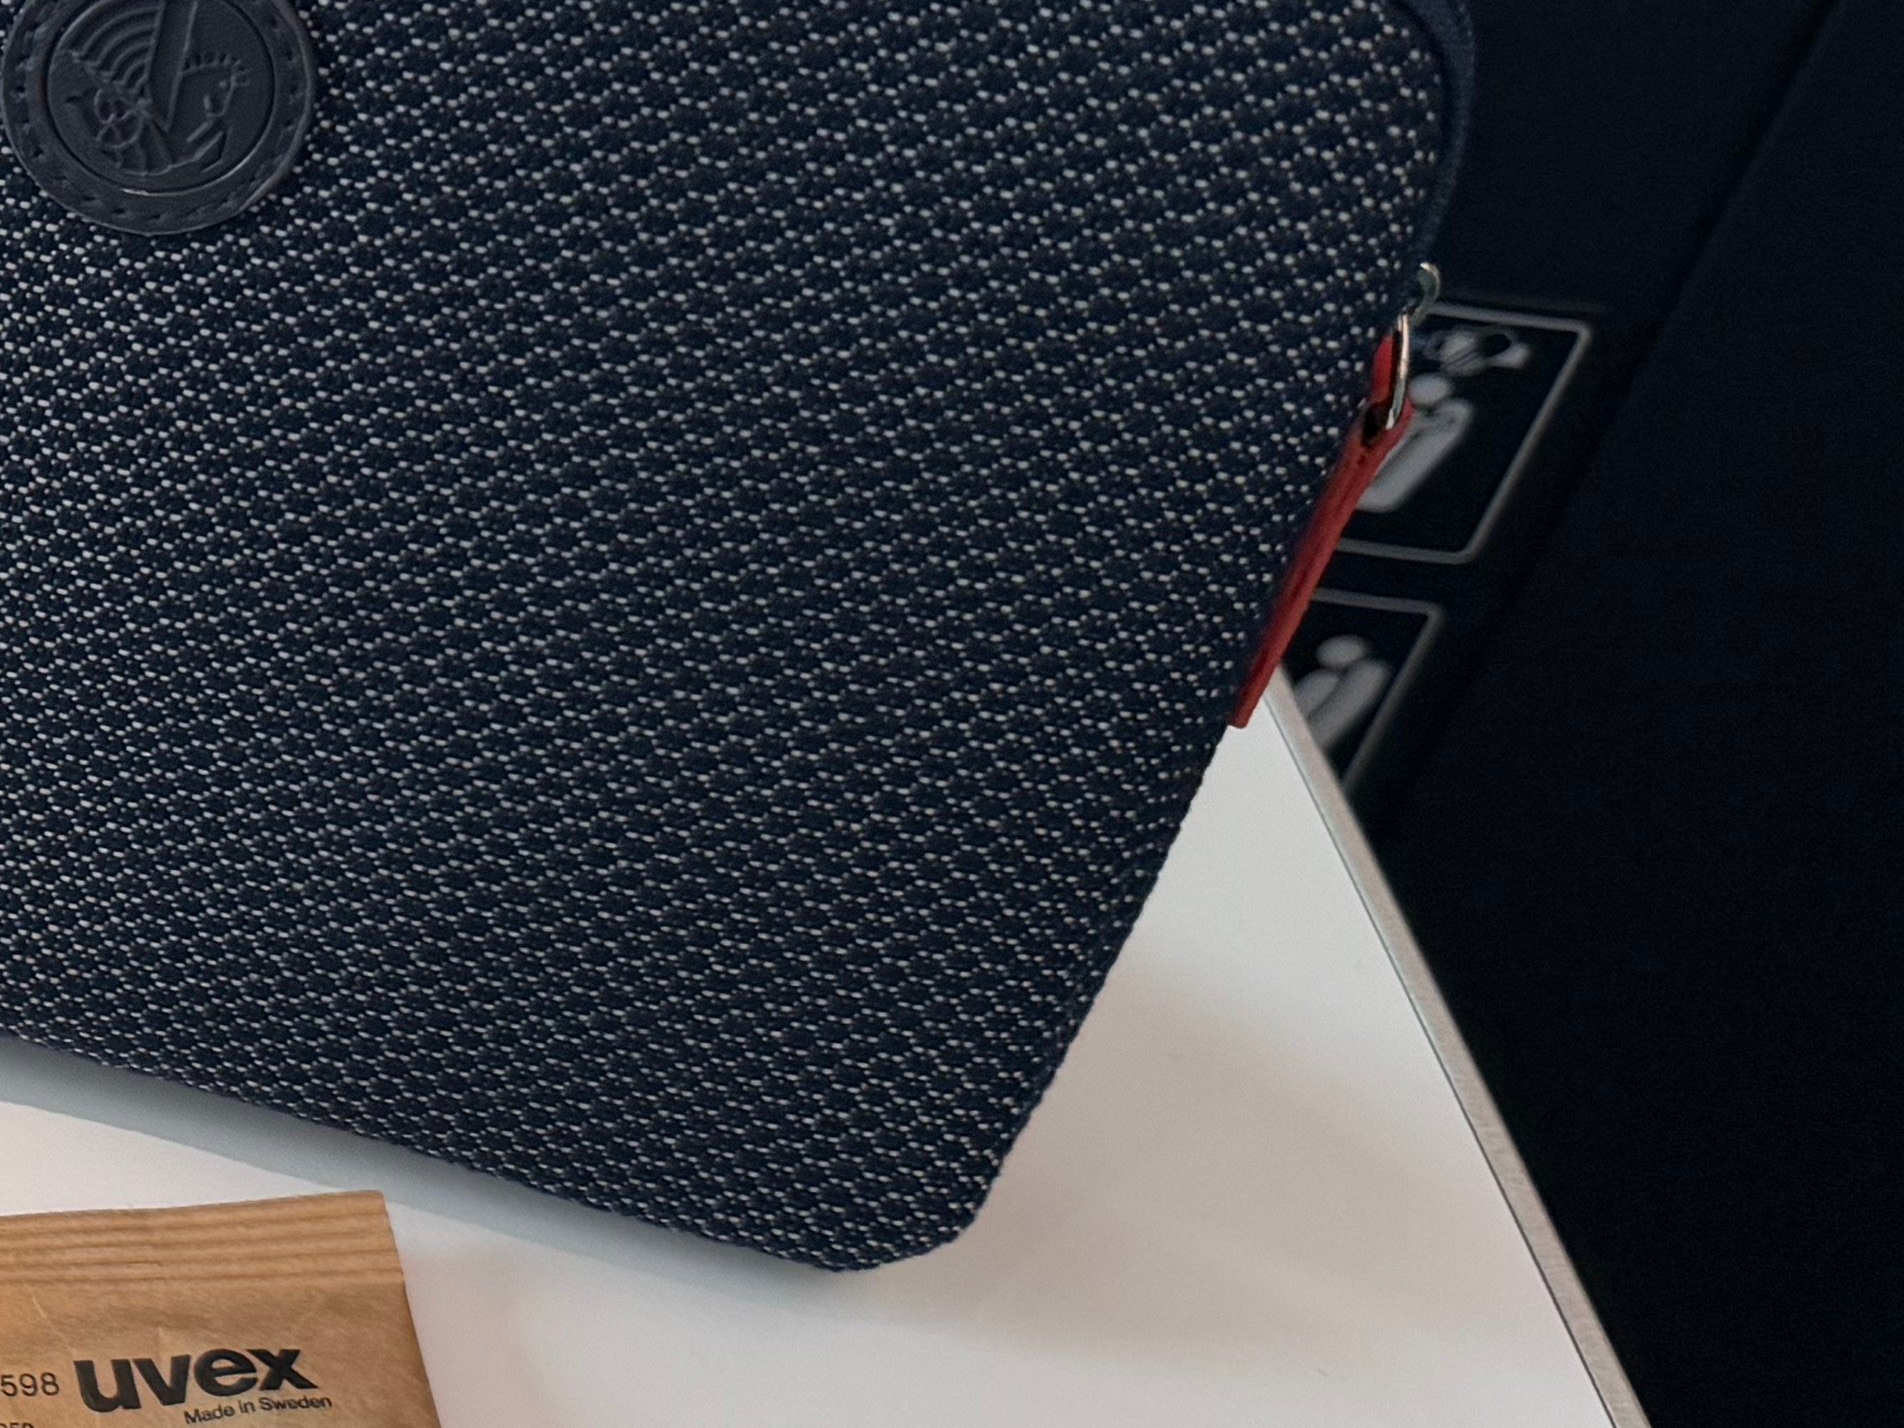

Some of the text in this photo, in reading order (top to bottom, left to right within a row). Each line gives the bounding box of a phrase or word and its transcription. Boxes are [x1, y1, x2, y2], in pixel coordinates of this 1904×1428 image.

[72, 1347, 318, 1413] uvex
[184, 1394, 333, 1426] Made in Sweden
